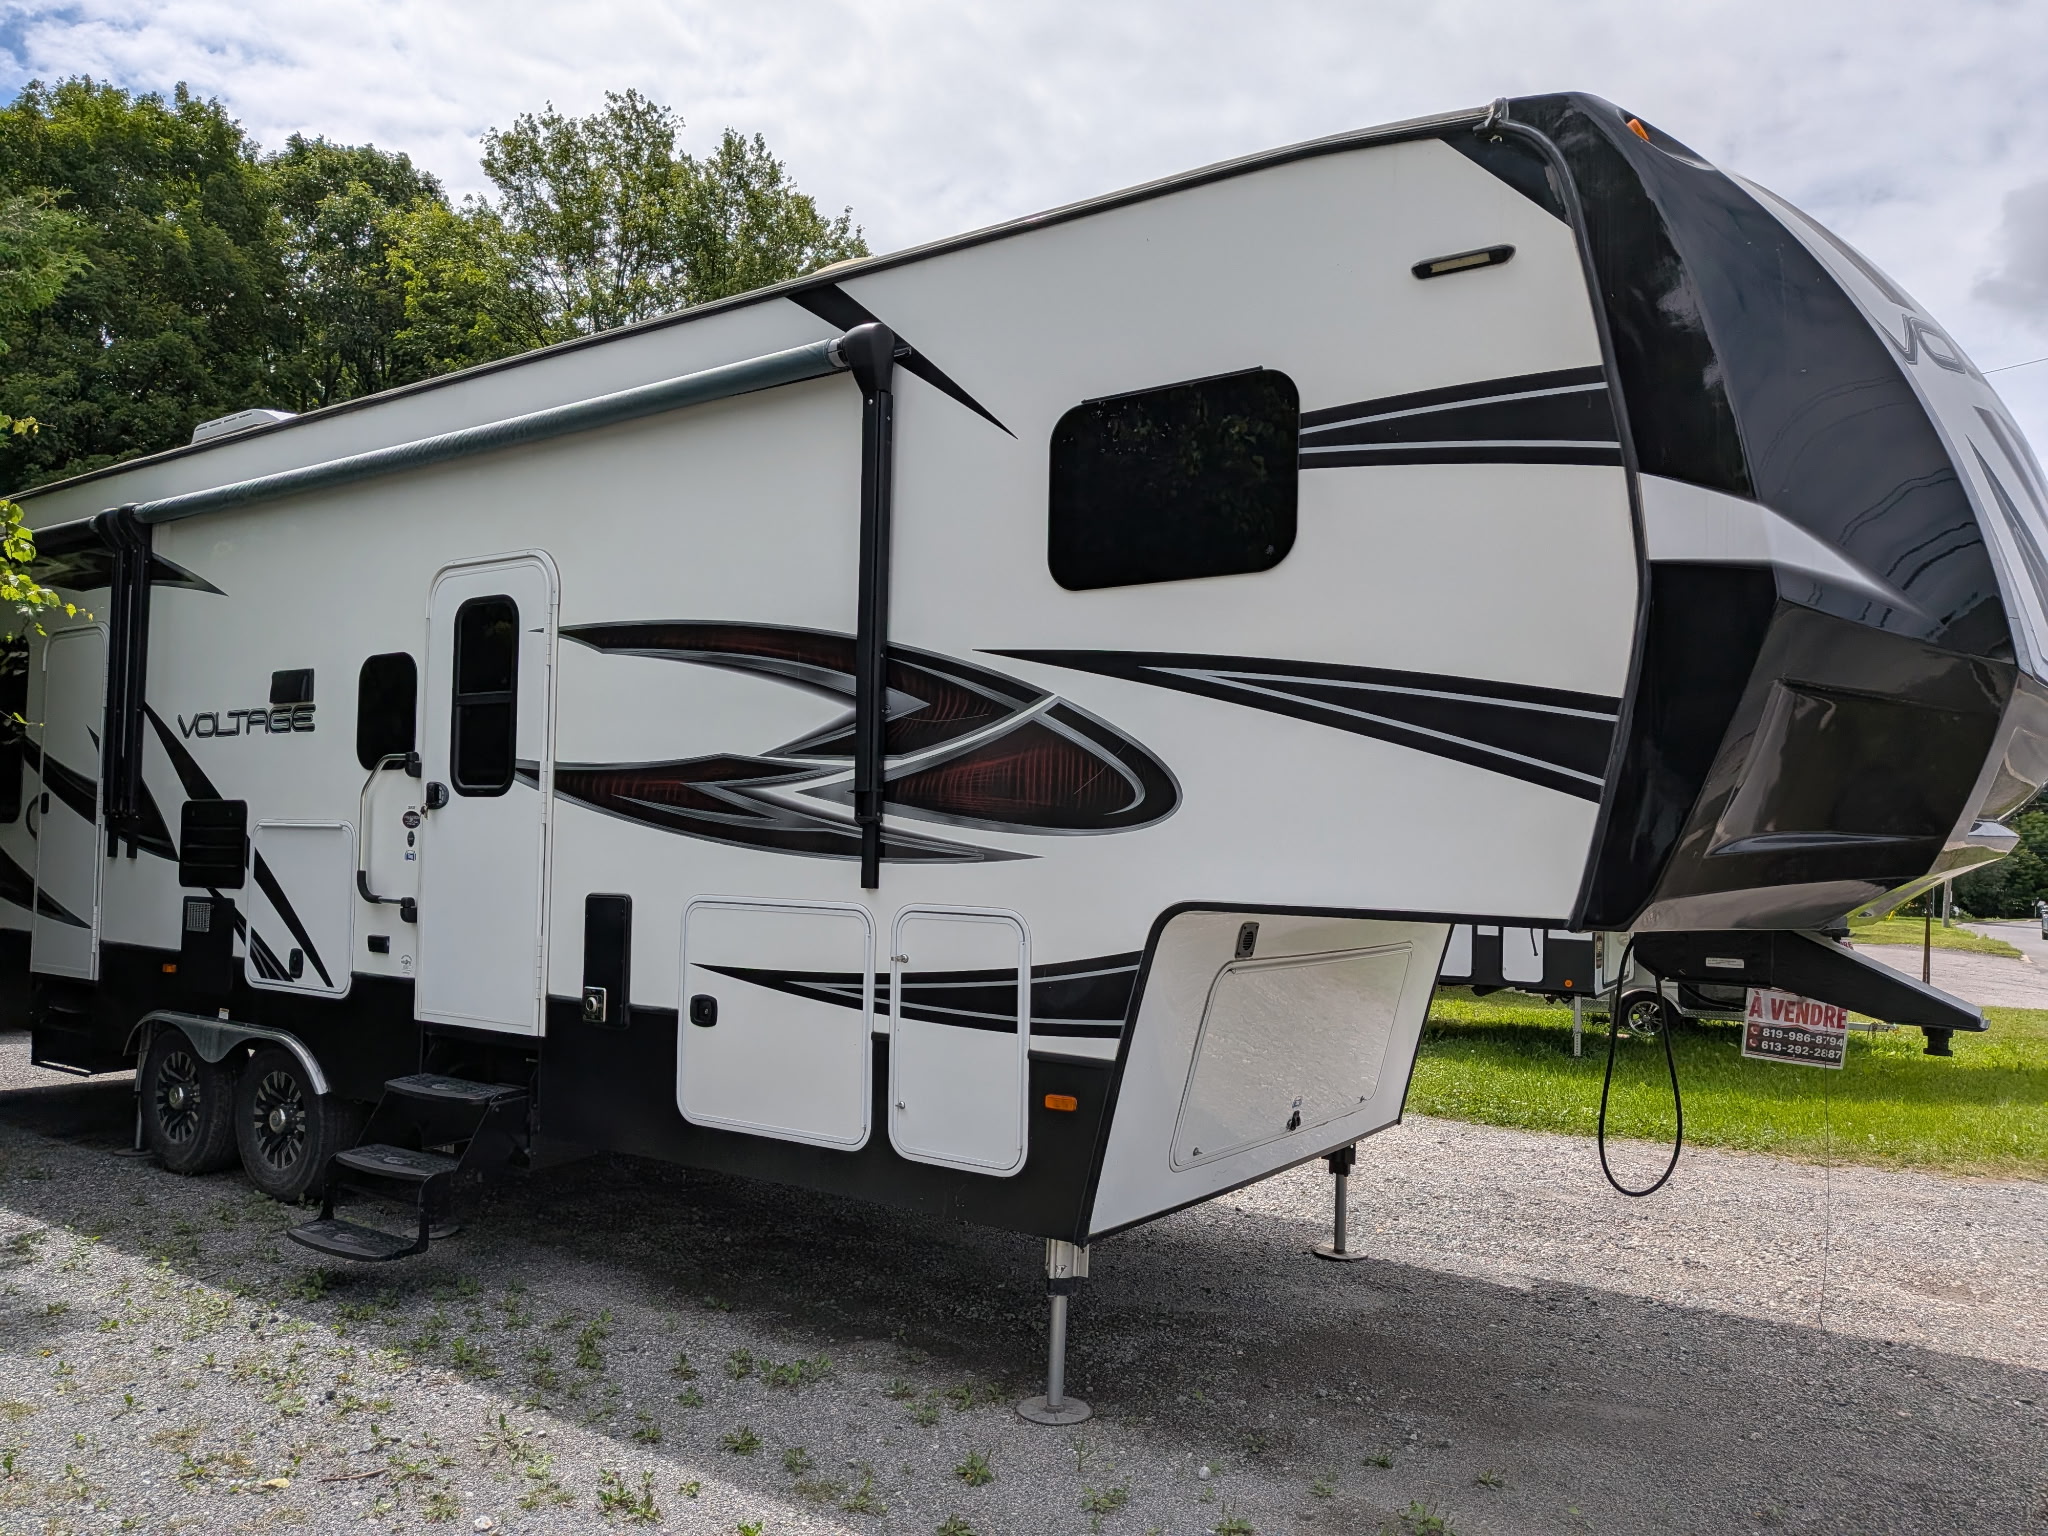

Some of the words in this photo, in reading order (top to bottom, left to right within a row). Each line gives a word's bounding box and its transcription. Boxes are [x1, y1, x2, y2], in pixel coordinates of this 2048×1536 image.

[177, 703, 316, 739] VOLTAGE
[1748, 990, 1763, 1018] À
[1770, 998, 1848, 1029] VENDRE
[1761, 1040, 1842, 1059] 613-292-2887
[1762, 1027, 1844, 1047] 819-986-8794
